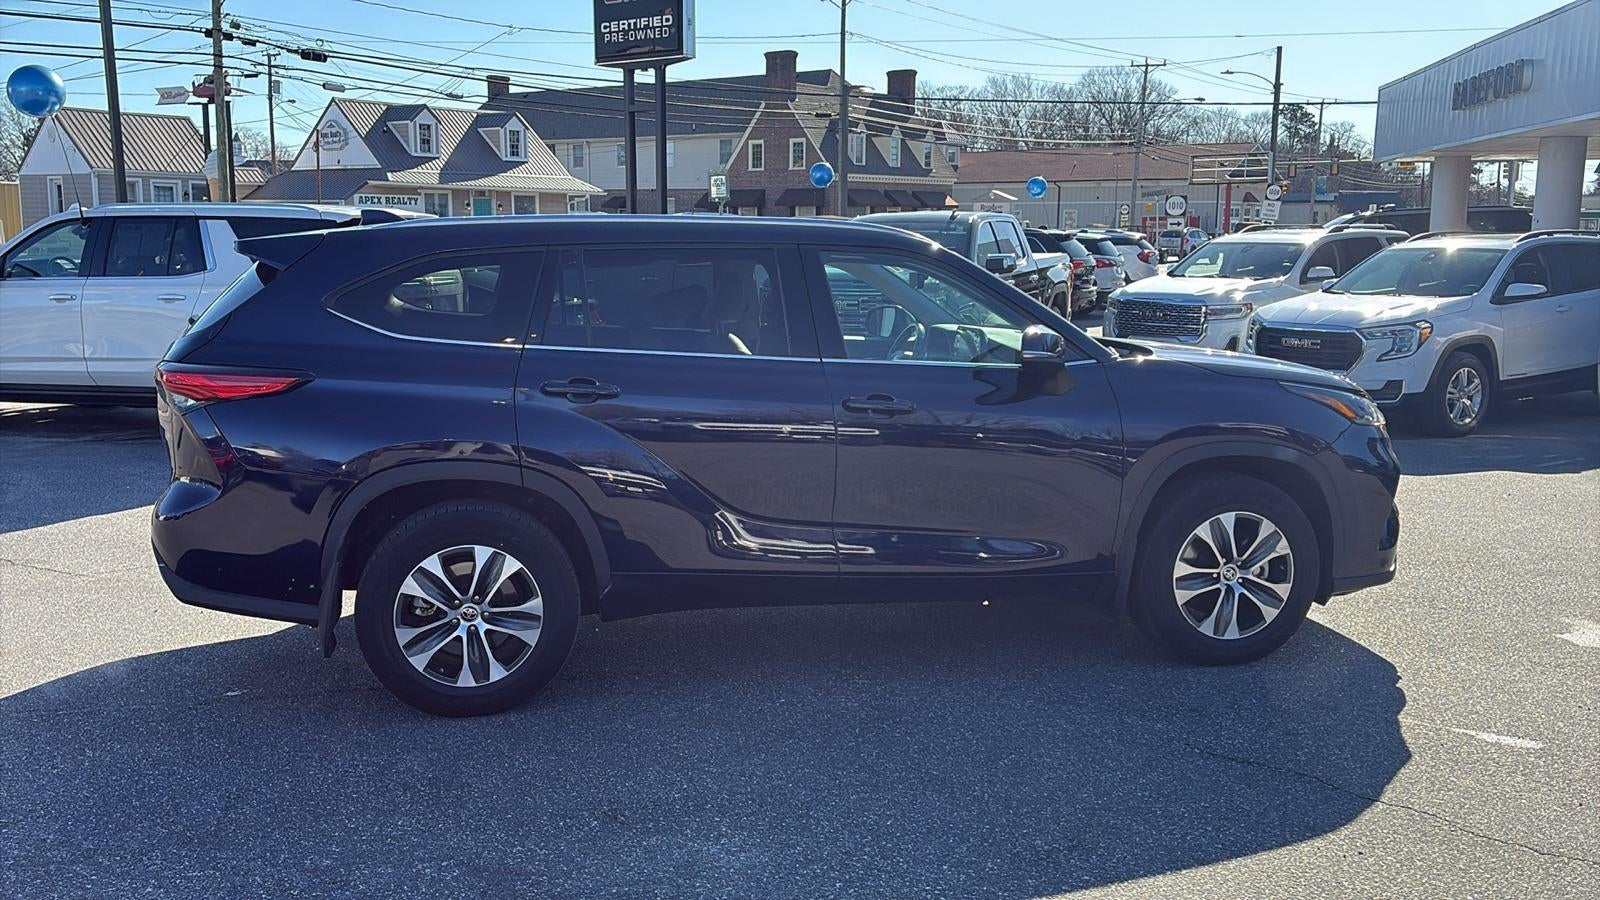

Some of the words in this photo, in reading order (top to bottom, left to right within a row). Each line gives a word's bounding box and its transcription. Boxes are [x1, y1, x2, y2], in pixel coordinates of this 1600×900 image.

[601, 15, 673, 33] CERTIFIED
[604, 27, 669, 43] PRE-OWNED
[358, 195, 382, 205] APEX
[385, 196, 419, 206] REALTY
[1168, 201, 1184, 210] 1010
[1281, 337, 1321, 349] GMC
